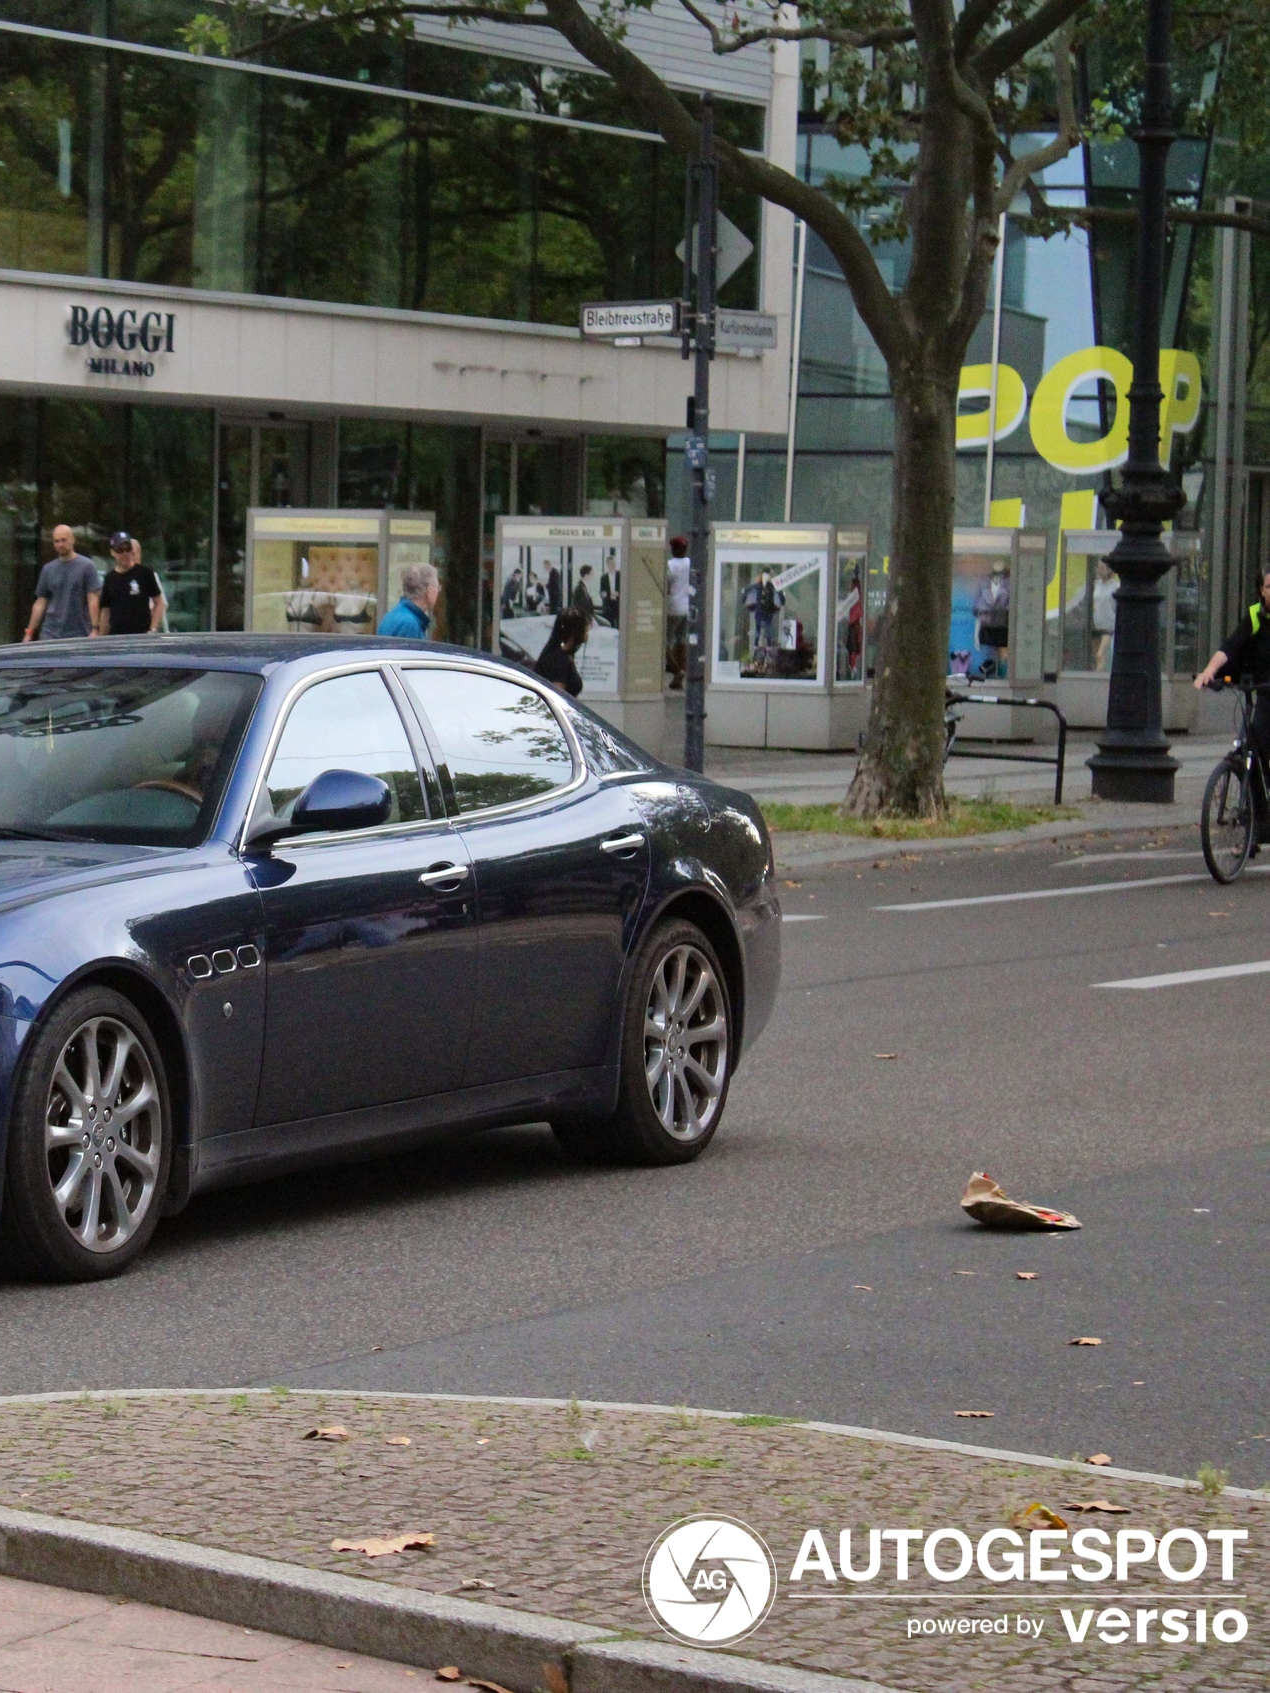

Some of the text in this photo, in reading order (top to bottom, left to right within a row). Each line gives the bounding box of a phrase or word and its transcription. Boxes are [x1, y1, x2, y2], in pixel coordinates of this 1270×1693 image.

[587, 304, 671, 327] Bleibtreustraße
[69, 305, 176, 353] BOGGI
[89, 357, 155, 377] MILANO
